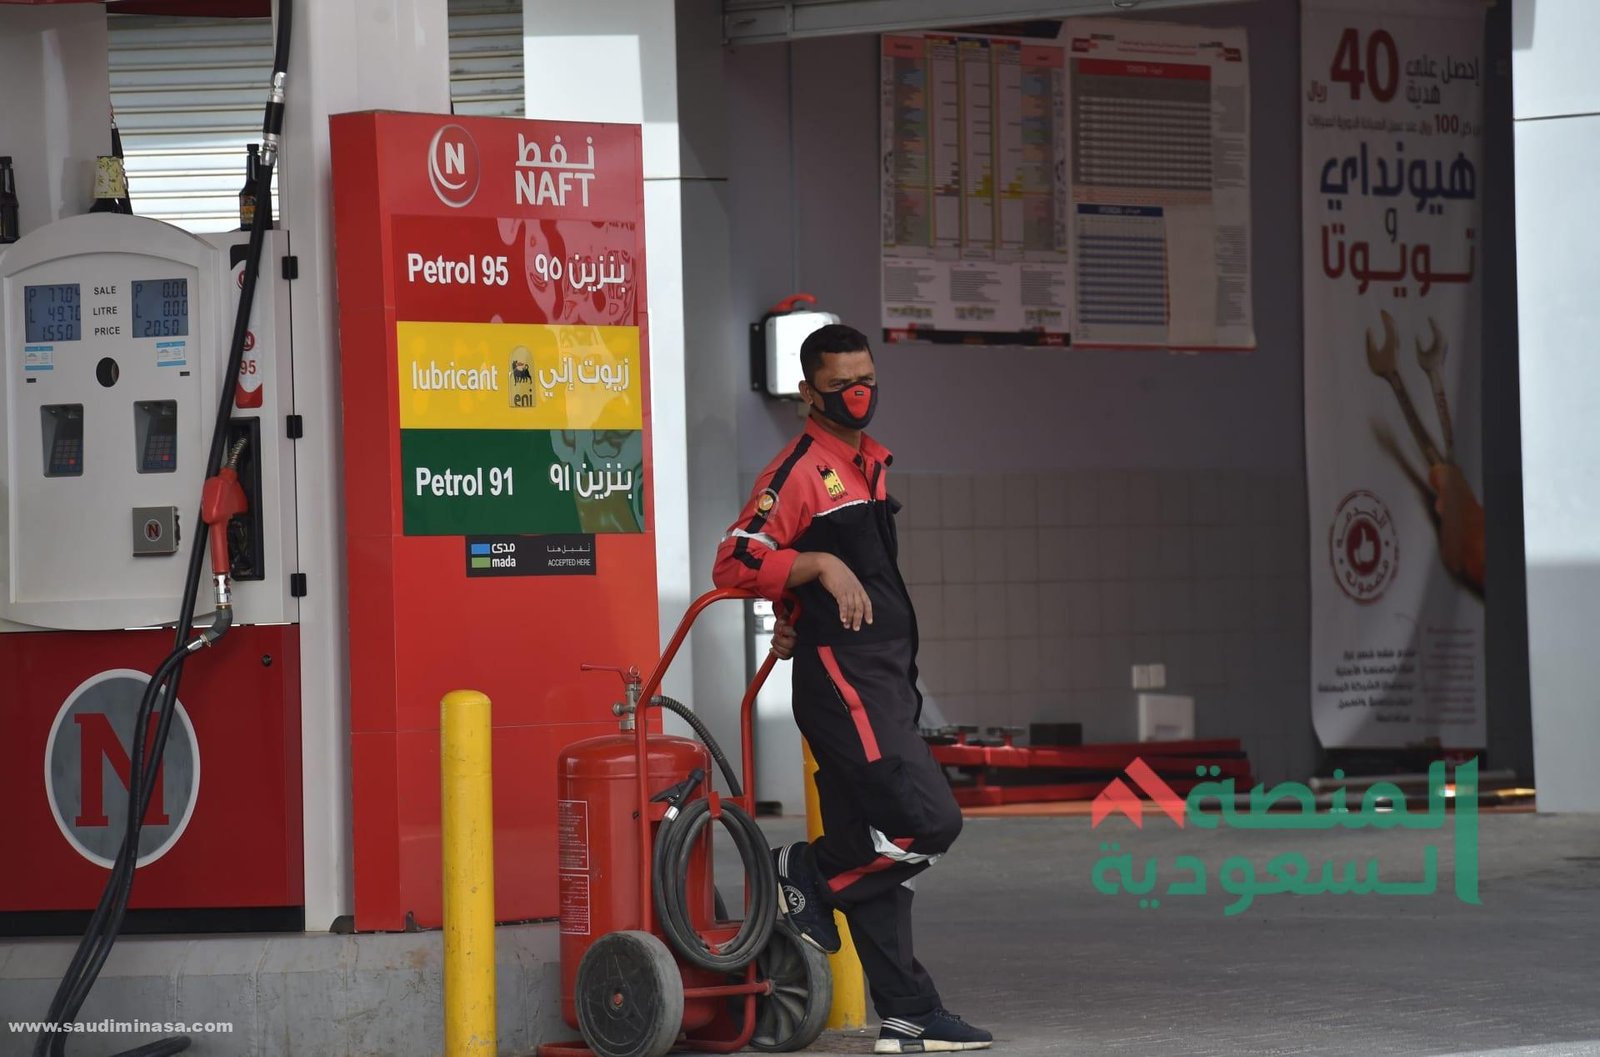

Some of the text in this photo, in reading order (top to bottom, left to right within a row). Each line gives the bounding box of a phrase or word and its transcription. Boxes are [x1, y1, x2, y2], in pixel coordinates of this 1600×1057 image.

[1330, 28, 1399, 103] 40
[1434, 114, 1459, 134] 100
[445, 142, 466, 175] N
[515, 133, 595, 169] نفط
[515, 170, 596, 207] NAFT
[1320, 140, 1477, 215] هيونداي
[1385, 207, 1397, 243] و
[407, 253, 509, 286] Petrol 95
[535, 253, 626, 293] بنزين ٩٥
[1321, 223, 1476, 298] تويوتا
[94, 286, 117, 296] SALE
[93, 306, 118, 316] LITRE
[94, 326, 121, 336] PRICE
[239, 360, 256, 375] 95
[412, 360, 498, 390] lubricant
[577, 358, 630, 392] زيوت
[513, 389, 533, 407] eni
[416, 466, 514, 496] Petrol 91
[550, 462, 633, 500] بنزين ٩١
[491, 543, 516, 554] مدى
[492, 555, 517, 568] mada
[548, 558, 591, 567] ACCEPTED HERE
[74, 711, 169, 827] N
